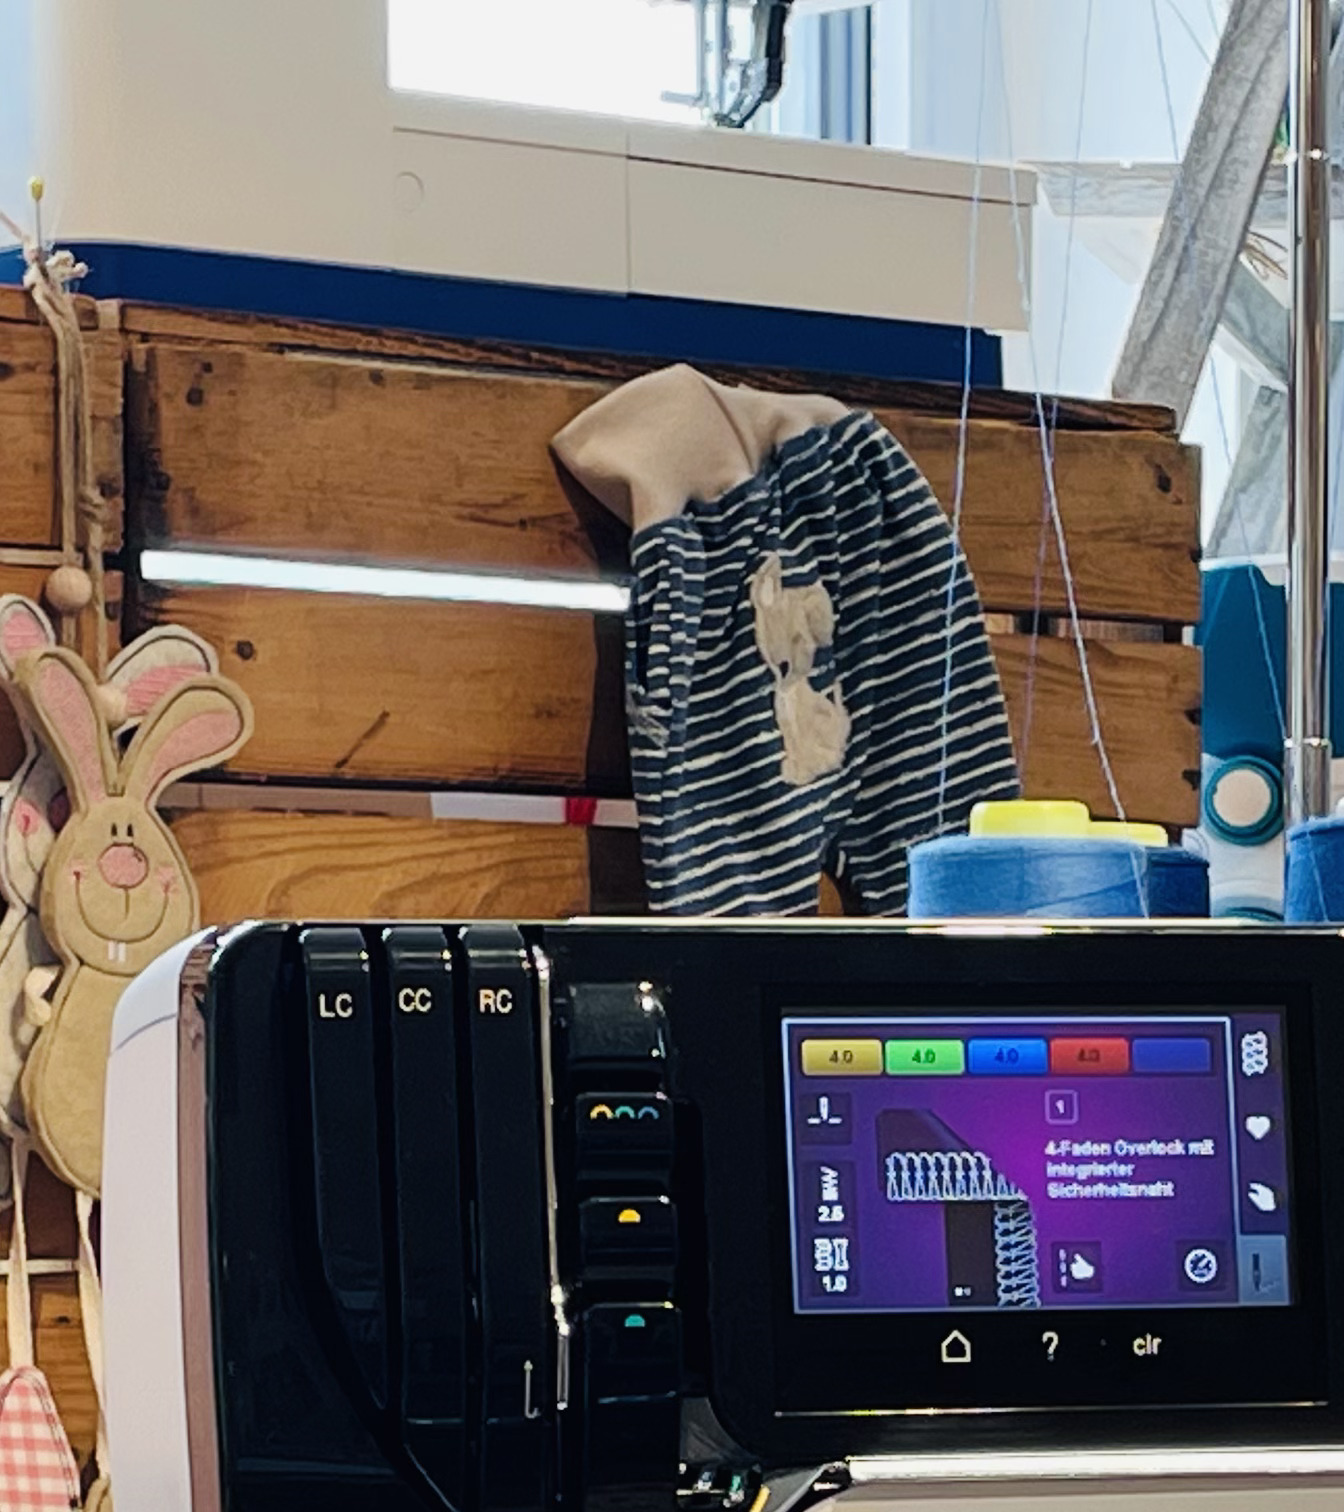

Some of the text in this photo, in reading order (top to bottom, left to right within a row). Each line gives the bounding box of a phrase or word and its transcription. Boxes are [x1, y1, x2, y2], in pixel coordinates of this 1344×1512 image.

[319, 993, 353, 1018] LC
[398, 988, 432, 1013] CC
[479, 989, 513, 1014] RC
[829, 1049, 854, 1064] 4.0
[911, 1049, 936, 1064] 4.0
[994, 1049, 1019, 1064] 4.0
[1044, 1139, 1215, 1156] 4-Faden Overlock mit
[1047, 1182, 1174, 1198] Sicherheitsnaht
[1132, 1333, 1162, 1356] clr
